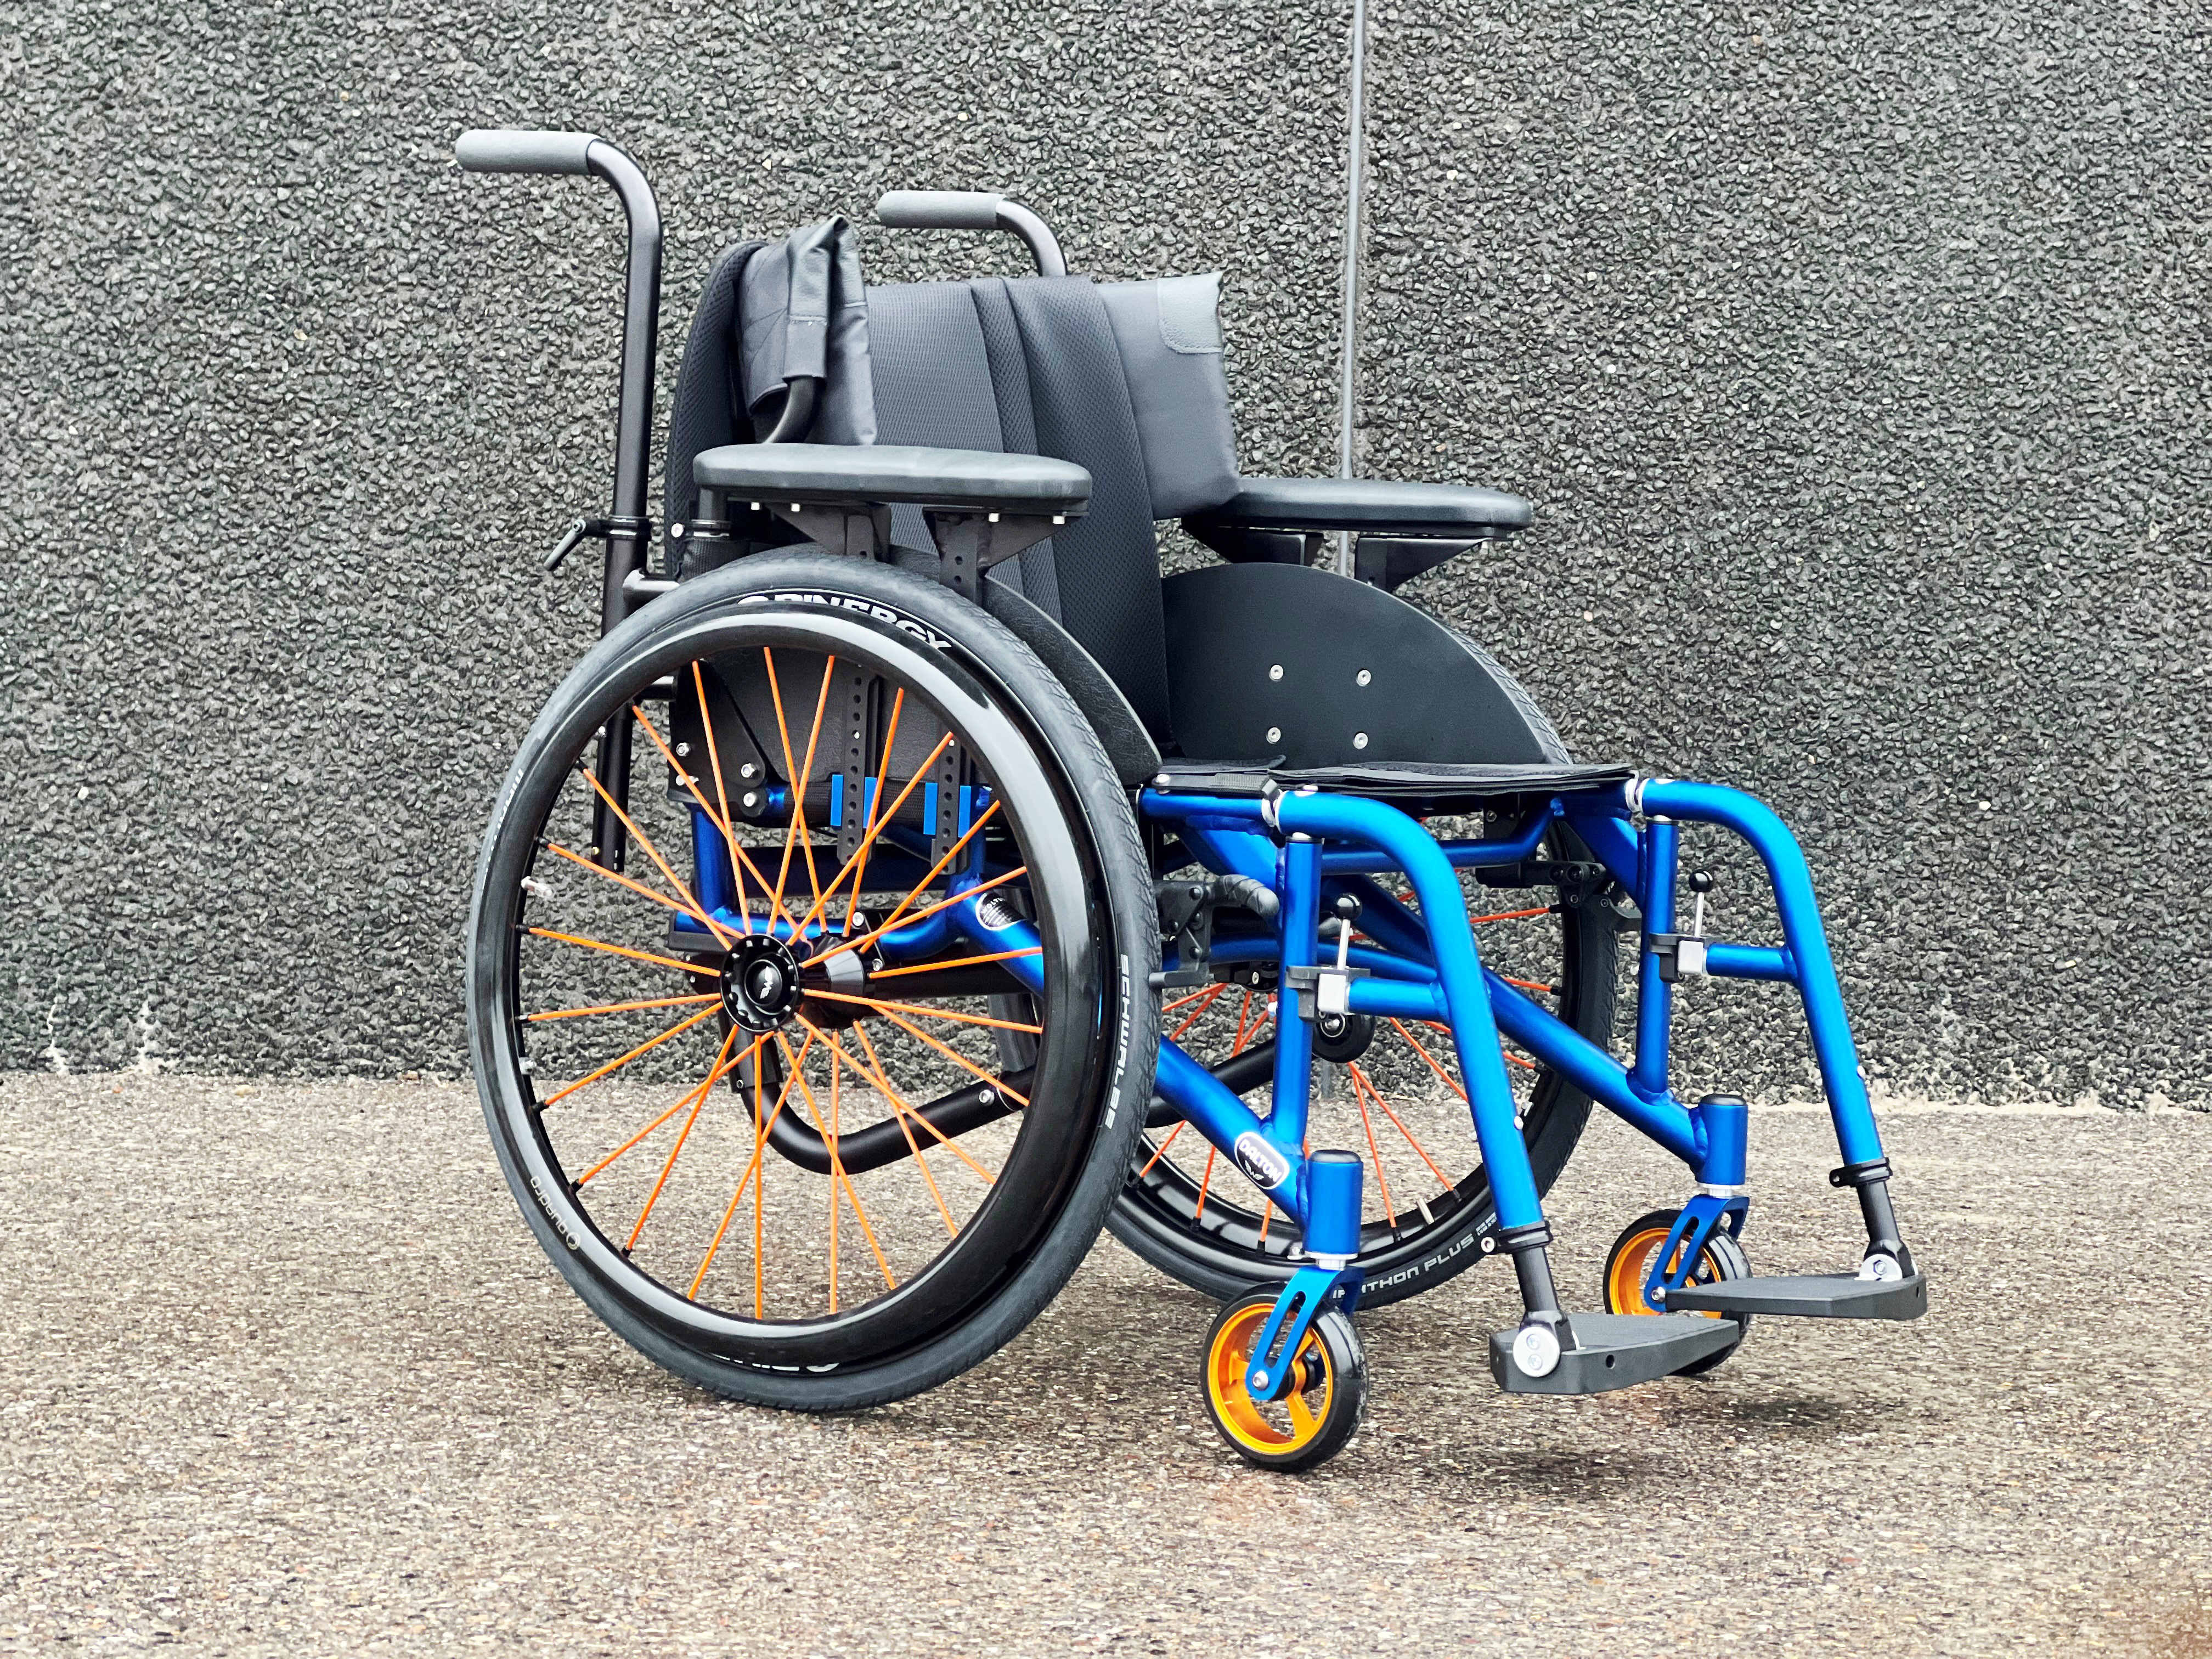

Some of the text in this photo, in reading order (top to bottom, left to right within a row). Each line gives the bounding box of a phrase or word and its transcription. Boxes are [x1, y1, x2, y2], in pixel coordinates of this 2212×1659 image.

[1105, 953, 1130, 1130] SCHWALBE
[1239, 1139, 1282, 1182] DALTON
[1424, 1233, 1474, 1272] PLUS
